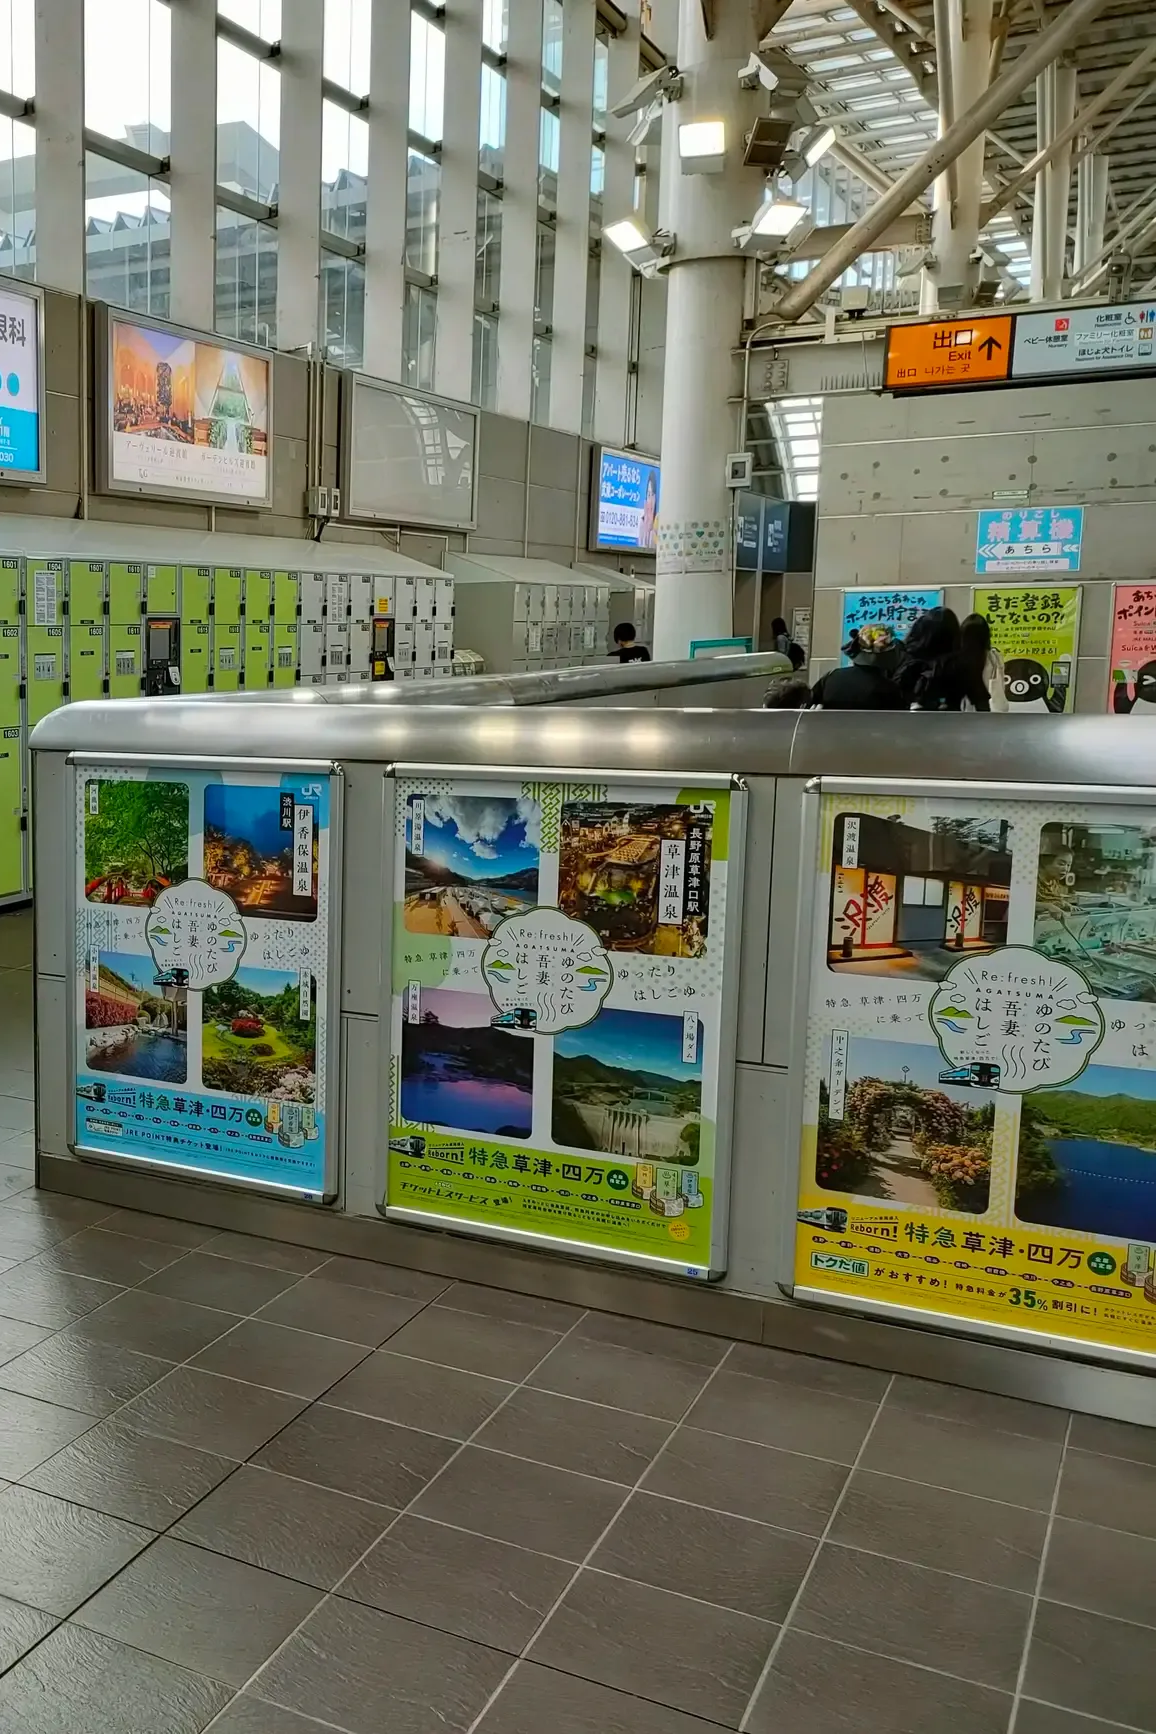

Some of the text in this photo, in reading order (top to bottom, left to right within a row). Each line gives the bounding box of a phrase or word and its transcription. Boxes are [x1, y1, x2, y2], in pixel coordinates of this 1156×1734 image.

[933, 329, 973, 350] 出口
[948, 350, 971, 362] Exit
[897, 368, 917, 379] 出口
[1002, 509, 1060, 520] のりこし
[1005, 544, 1052, 555] あちら
[3, 560, 17, 568] 1601
[987, 593, 1064, 612] まだ登録
[1132, 590, 1156, 602] あち
[846, 605, 928, 623] ポイント貯ま
[1117, 605, 1156, 620] ポイン
[4, 629, 18, 637] 1602
[4, 729, 18, 737] 1603
[301, 784, 322, 796] JR
[282, 796, 293, 828] 渋川駅
[414, 801, 422, 852] 川原湯温泉
[297, 808, 310, 891] 伊香保温泉
[846, 820, 857, 867] 沢渡温泉
[688, 828, 702, 913] 長野原草津口駅
[664, 844, 682, 919] 草津温泉
[172, 918, 182, 956] はしご
[188, 919, 199, 948] 吾妻
[250, 928, 294, 941] ゆったり
[206, 923, 218, 974] ゆのたび
[516, 943, 575, 953] AGATSUMA
[515, 952, 529, 994] はしご
[536, 954, 551, 986] 吾妻
[617, 965, 676, 980] ゆったり
[981, 970, 1053, 986] Re:fresh!
[560, 957, 574, 1015] ゆのたび
[975, 987, 1054, 1000] AGATSUMA
[876, 1012, 925, 1024] に乗って
[975, 997, 992, 1047] はしご
[1000, 1000, 1021, 1037] 吾妻
[1110, 1019, 1156, 1033] ゆっ
[1032, 1003, 1053, 1071] ゆのたび
[428, 1149, 464, 1161] Reborn!
[851, 1223, 898, 1239] Reborn!
[813, 1254, 948, 1289] トクだ値 がおすすめ!
[1008, 1287, 1048, 1312] 35%
[1052, 1299, 1098, 1316] 割引に!
